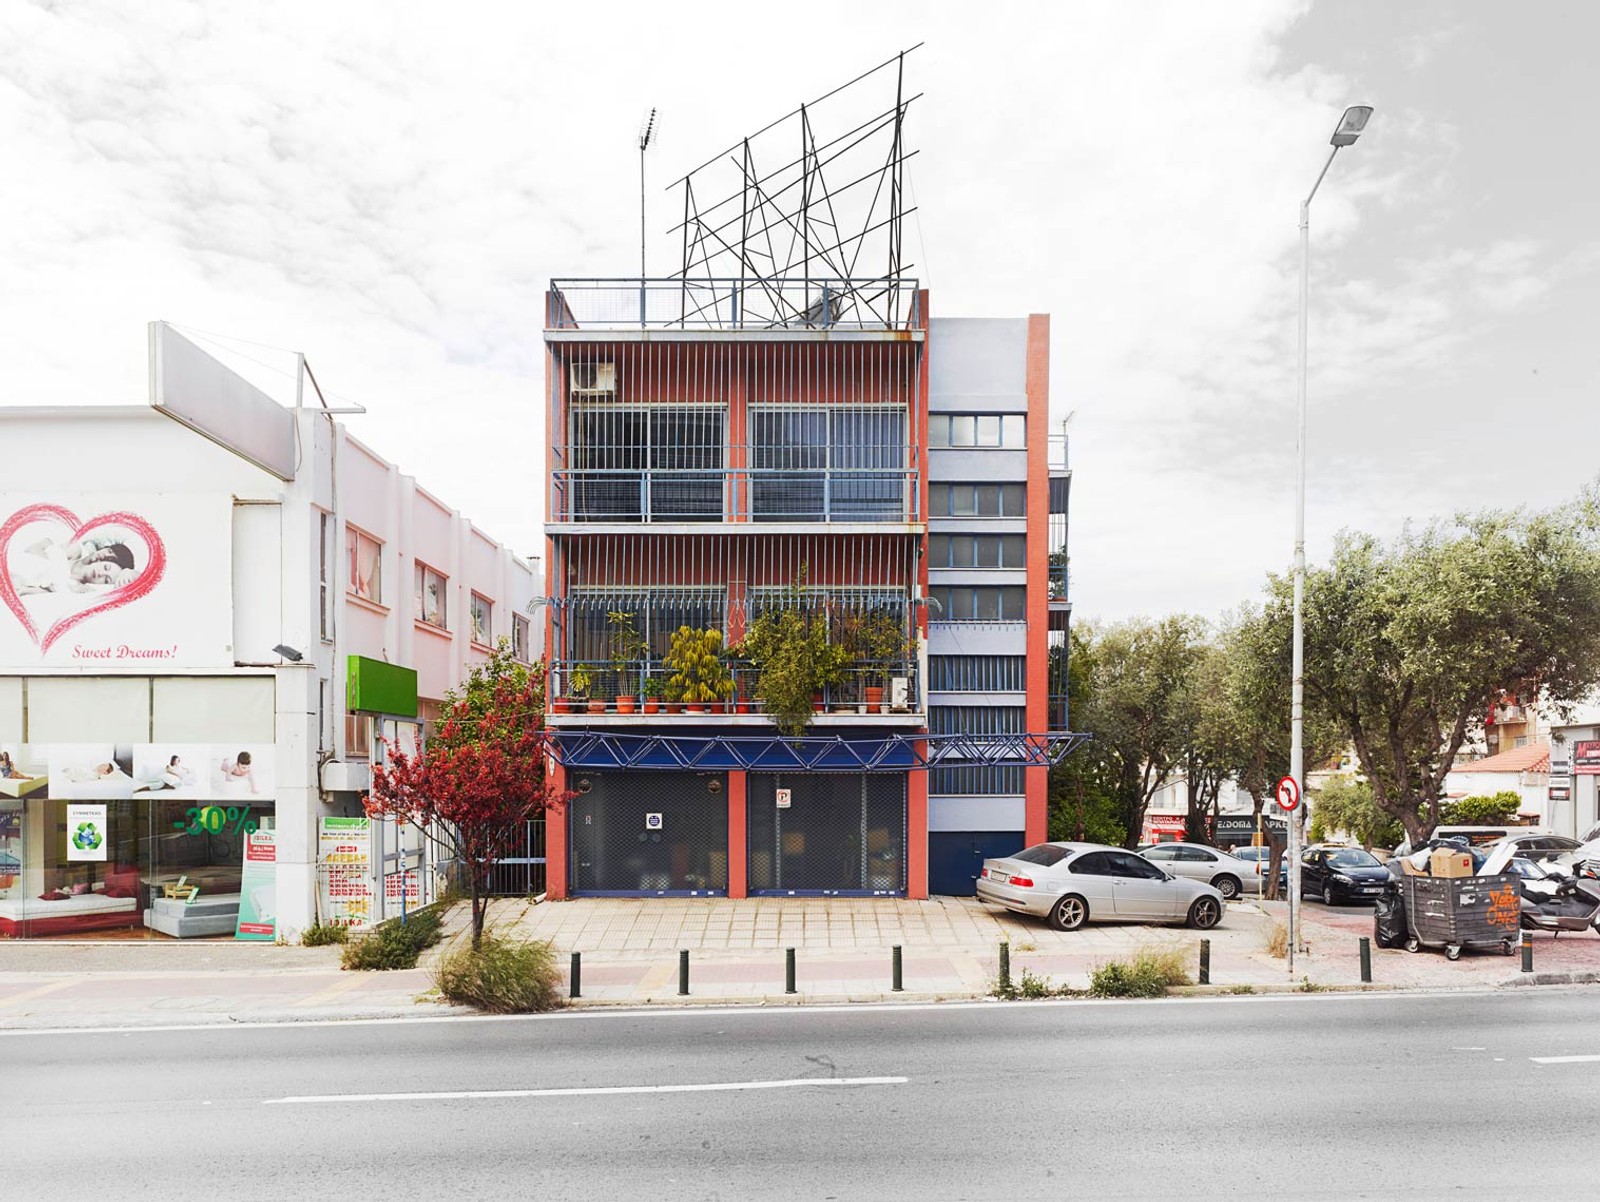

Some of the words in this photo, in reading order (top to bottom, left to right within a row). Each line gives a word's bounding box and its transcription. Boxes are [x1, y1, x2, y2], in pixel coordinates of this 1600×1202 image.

[72, 644, 112, 659] Sweet
[116, 644, 178, 659] Dreams!
[173, 803, 257, 836] -30%
